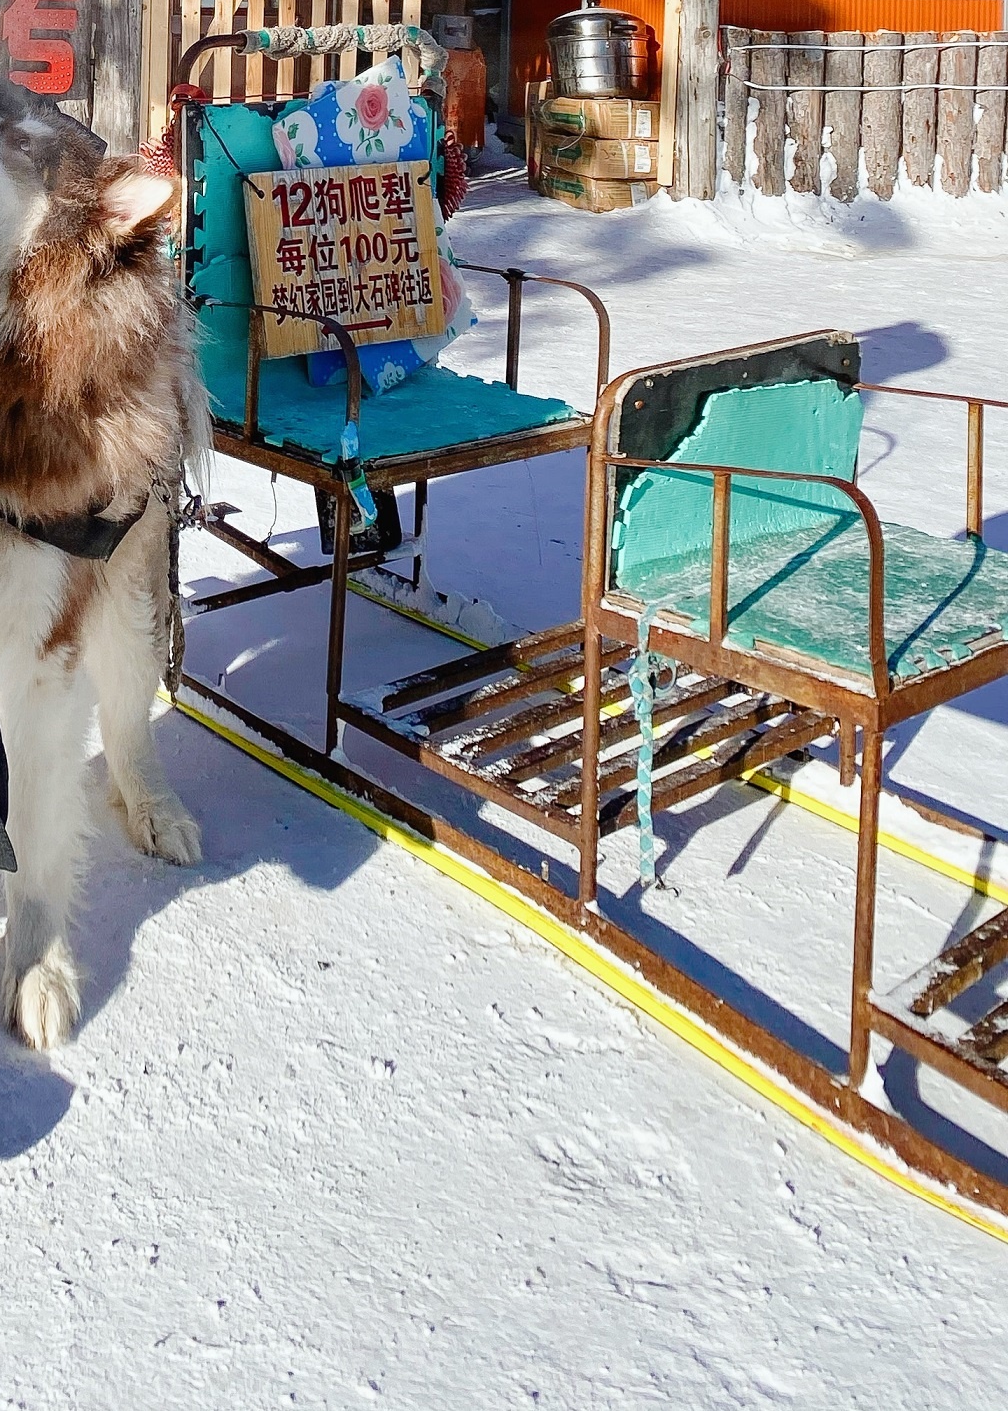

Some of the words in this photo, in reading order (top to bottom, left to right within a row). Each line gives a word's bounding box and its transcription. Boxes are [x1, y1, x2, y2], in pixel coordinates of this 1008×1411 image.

[271, 172, 414, 229] 12狗爬犁
[276, 228, 420, 276] 每位100元
[271, 267, 434, 326] 梦幻家园到大石碑往返
